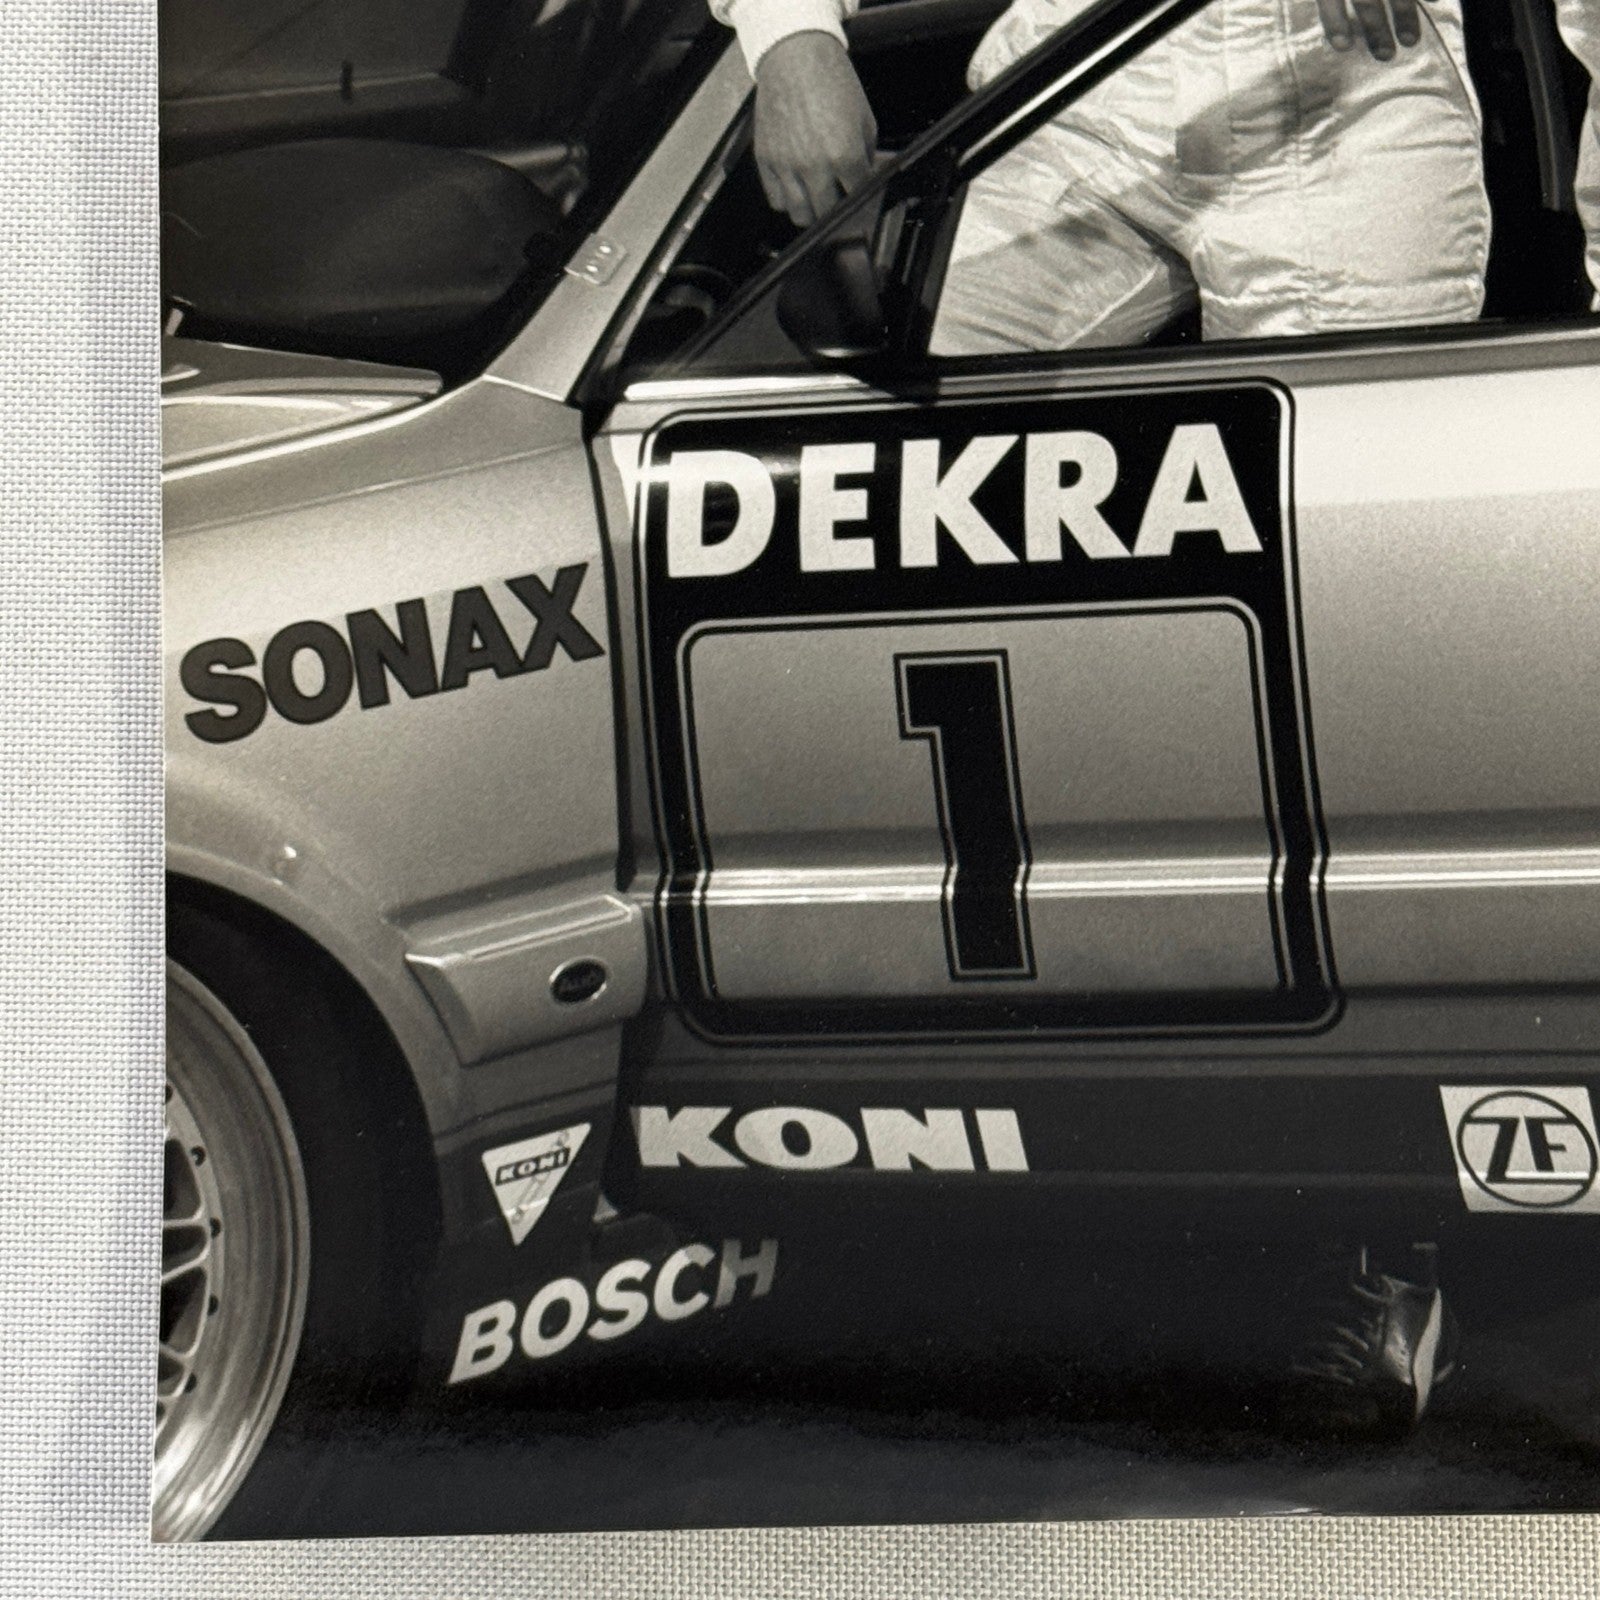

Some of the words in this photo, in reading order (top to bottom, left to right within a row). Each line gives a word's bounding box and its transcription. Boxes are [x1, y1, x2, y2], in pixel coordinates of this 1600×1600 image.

[667, 424, 1263, 577] DEKRA
[180, 562, 605, 744] SONAX
[893, 649, 1037, 981] 1
[498, 1150, 567, 1182] KONI
[631, 1106, 1029, 1171] KONI
[1465, 1116, 1589, 1185] ZF
[448, 1239, 778, 1384] BOSCH
